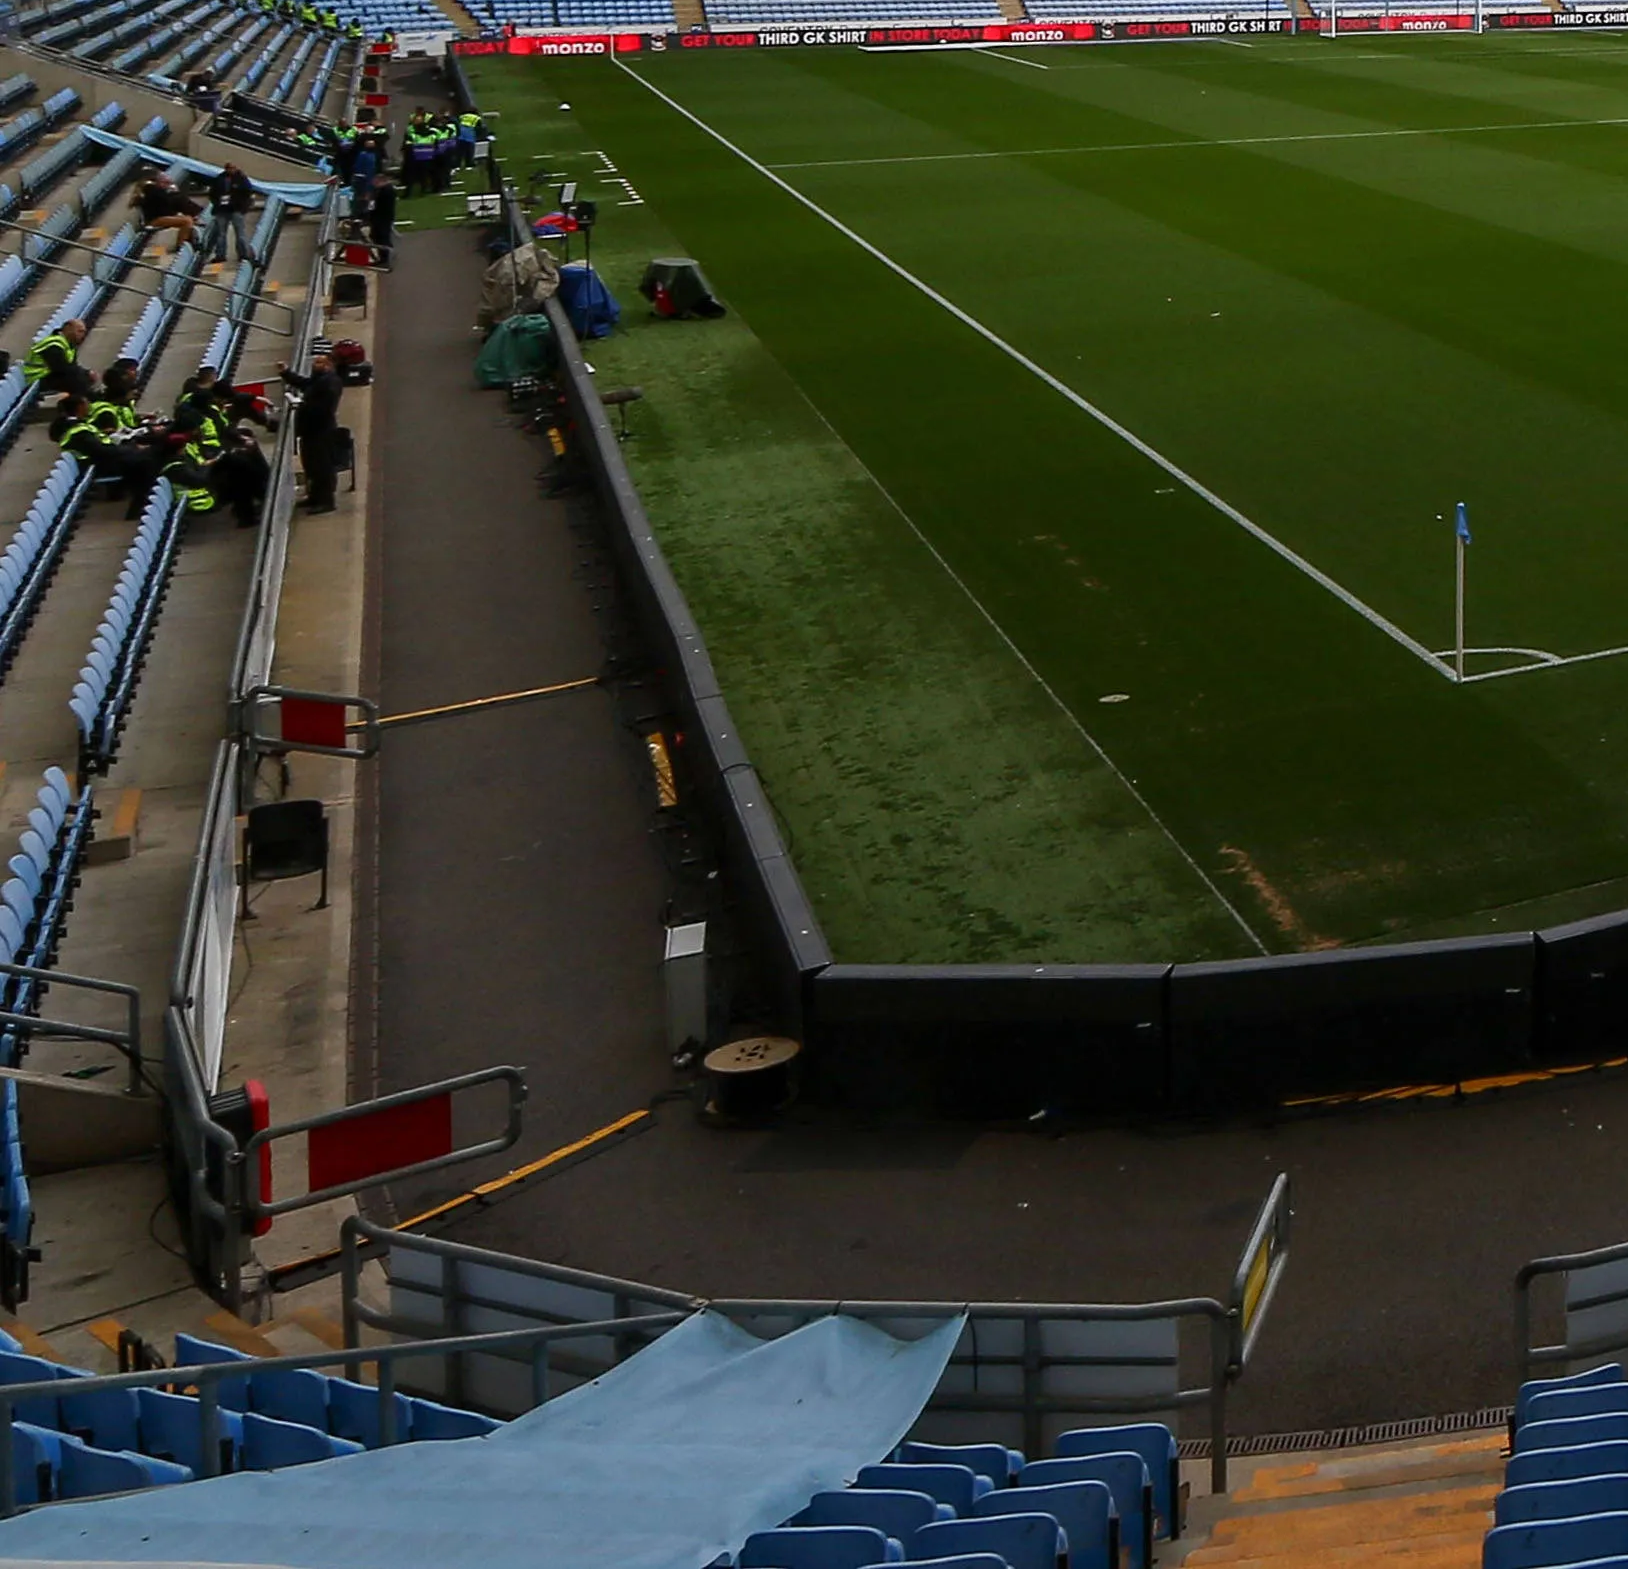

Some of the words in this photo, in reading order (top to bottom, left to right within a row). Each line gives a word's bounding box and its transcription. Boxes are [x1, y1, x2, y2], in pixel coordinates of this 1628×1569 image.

[1554, 13, 1583, 24] THIRD
[1586, 13, 1602, 24] GK
[1191, 22, 1225, 34] THIRD
[1228, 21, 1248, 33] GK
[1250, 21, 1282, 32] SHRT
[759, 32, 799, 45] THIRD
[803, 31, 825, 44] GK
[829, 31, 866, 43] SHIRT
[1011, 30, 1064, 41] monzo
[542, 42, 604, 55] monzo
